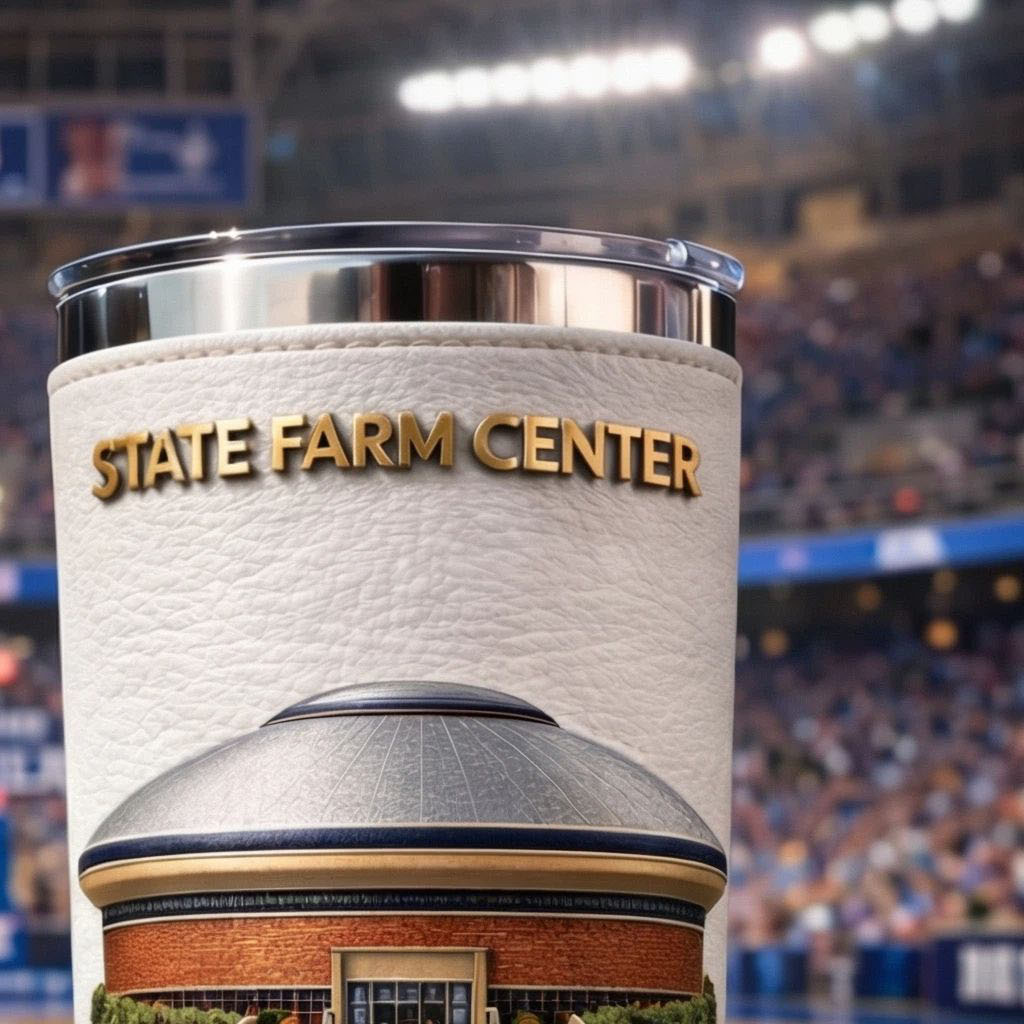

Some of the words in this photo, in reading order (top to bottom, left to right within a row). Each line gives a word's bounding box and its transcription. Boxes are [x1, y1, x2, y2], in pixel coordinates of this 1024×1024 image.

[91, 417, 253, 499] STATE
[271, 411, 455, 471] FARM
[473, 413, 703, 497] CENTER
